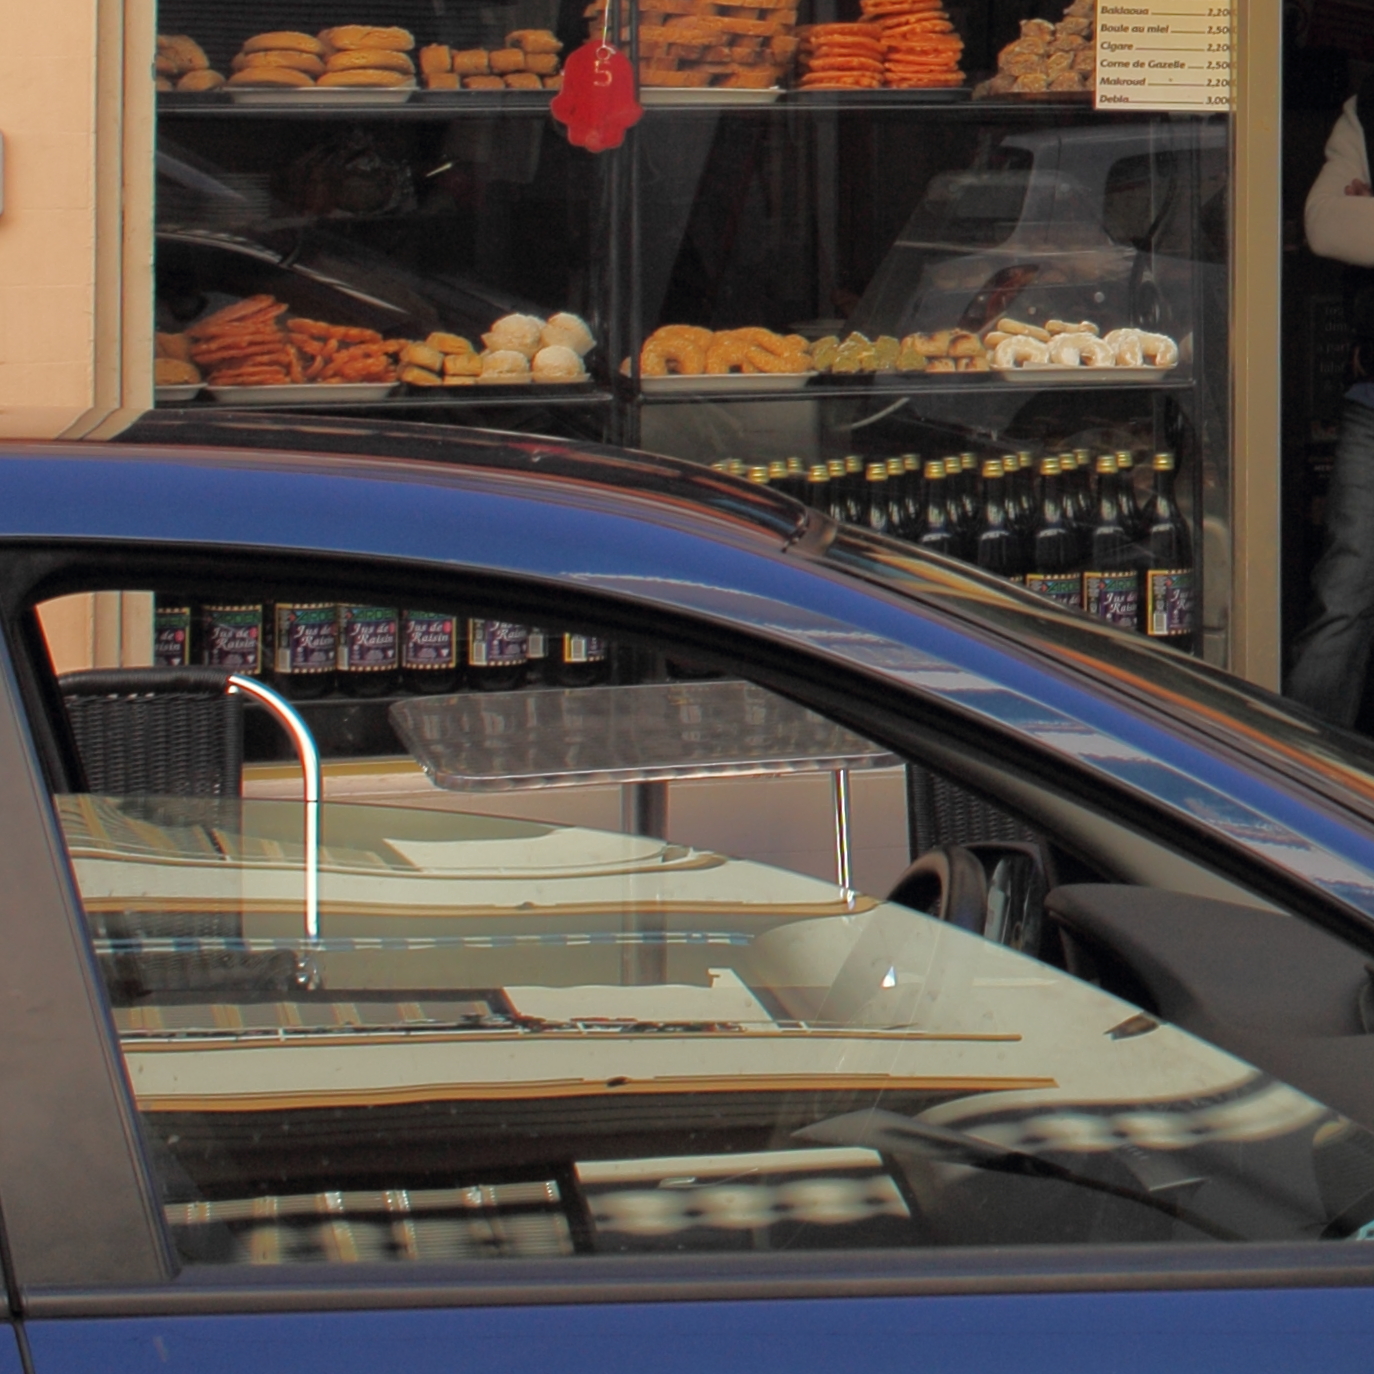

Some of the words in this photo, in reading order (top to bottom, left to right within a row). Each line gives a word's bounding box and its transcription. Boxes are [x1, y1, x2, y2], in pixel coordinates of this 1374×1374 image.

[1100, 24, 1129, 33] Boule
[1147, 24, 1170, 33] miel
[1100, 41, 1134, 53] Cigare
[1100, 59, 1131, 68] Corne
[1132, 60, 1146, 68] de
[1148, 59, 1186, 69] Gazelle
[293, 625, 318, 638] Jus
[350, 621, 375, 636] Jus
[376, 621, 389, 634] de
[406, 621, 427, 634] Jus
[428, 621, 442, 633] de
[215, 638, 255, 649] Raisin
[300, 636, 334, 648] Raisin
[356, 634, 394, 646] Raisin
[411, 632, 449, 644] Raisin
